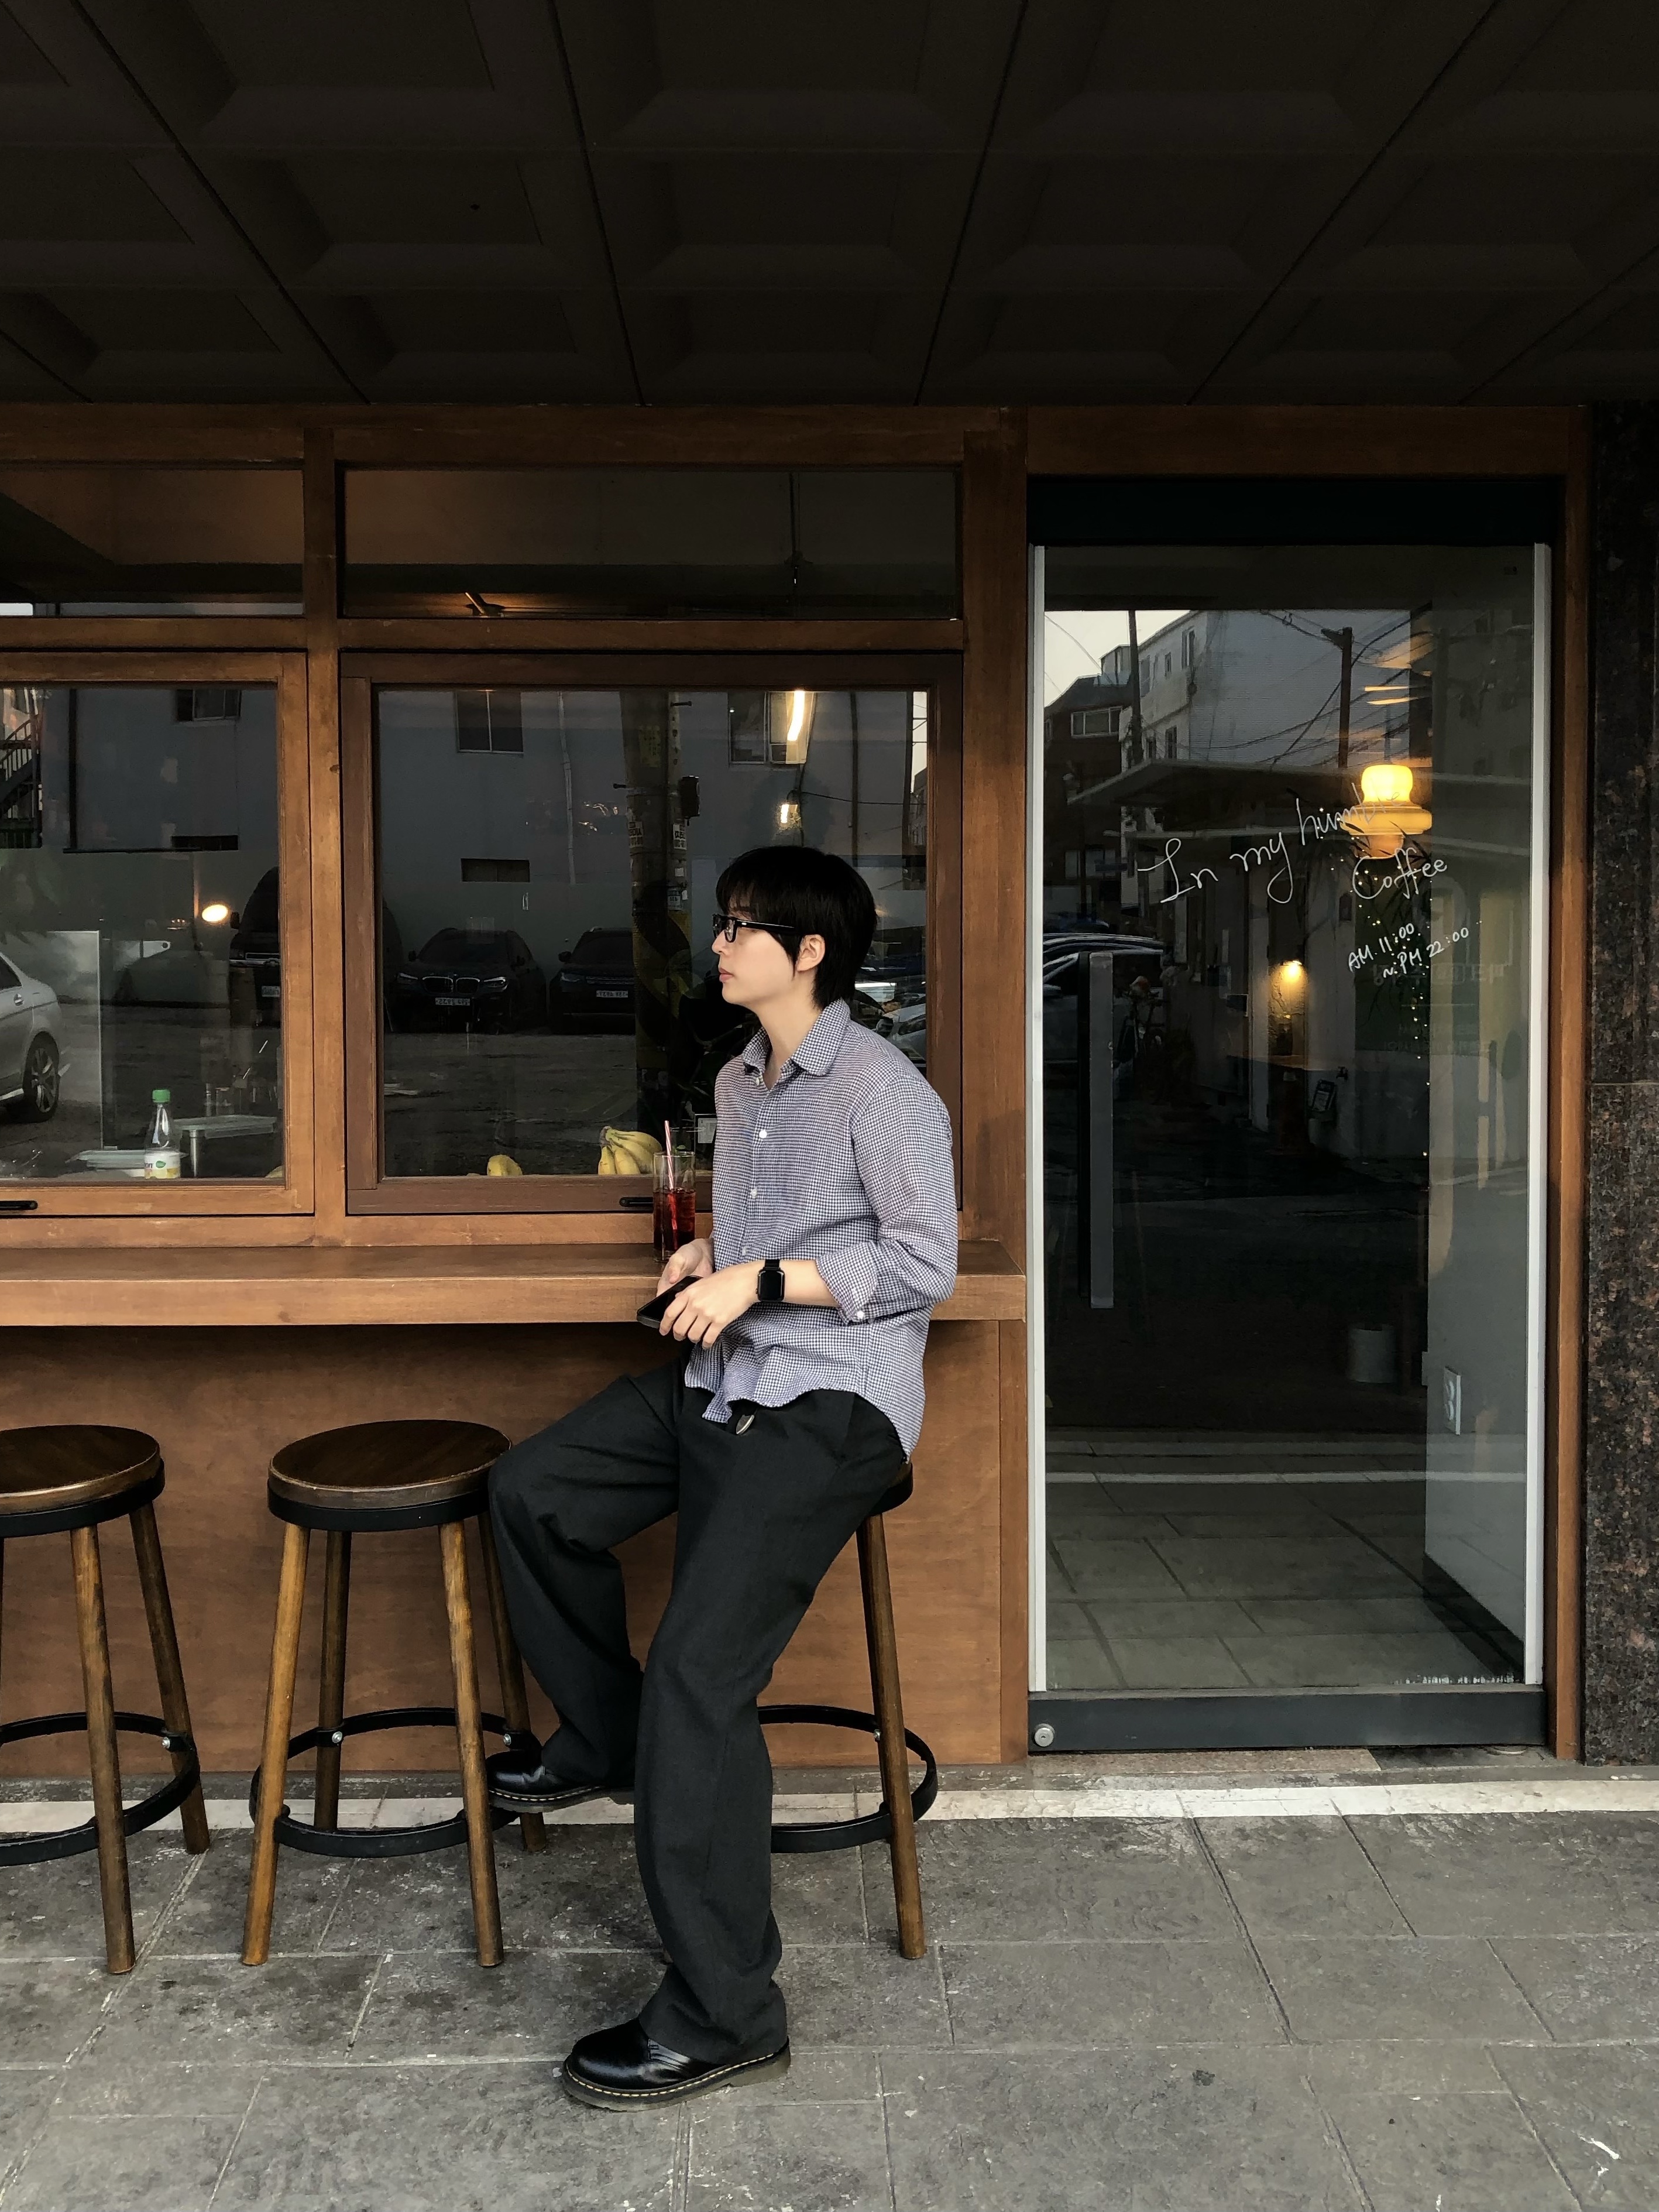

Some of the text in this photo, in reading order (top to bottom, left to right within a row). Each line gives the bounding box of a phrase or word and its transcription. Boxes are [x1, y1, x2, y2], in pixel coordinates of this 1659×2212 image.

[1137, 838, 1219, 903] In
[1229, 831, 1293, 904] my
[1352, 846, 1448, 899] Coffee
[1397, 948, 1423, 975] PM
[1426, 927, 1469, 958] 22:00
